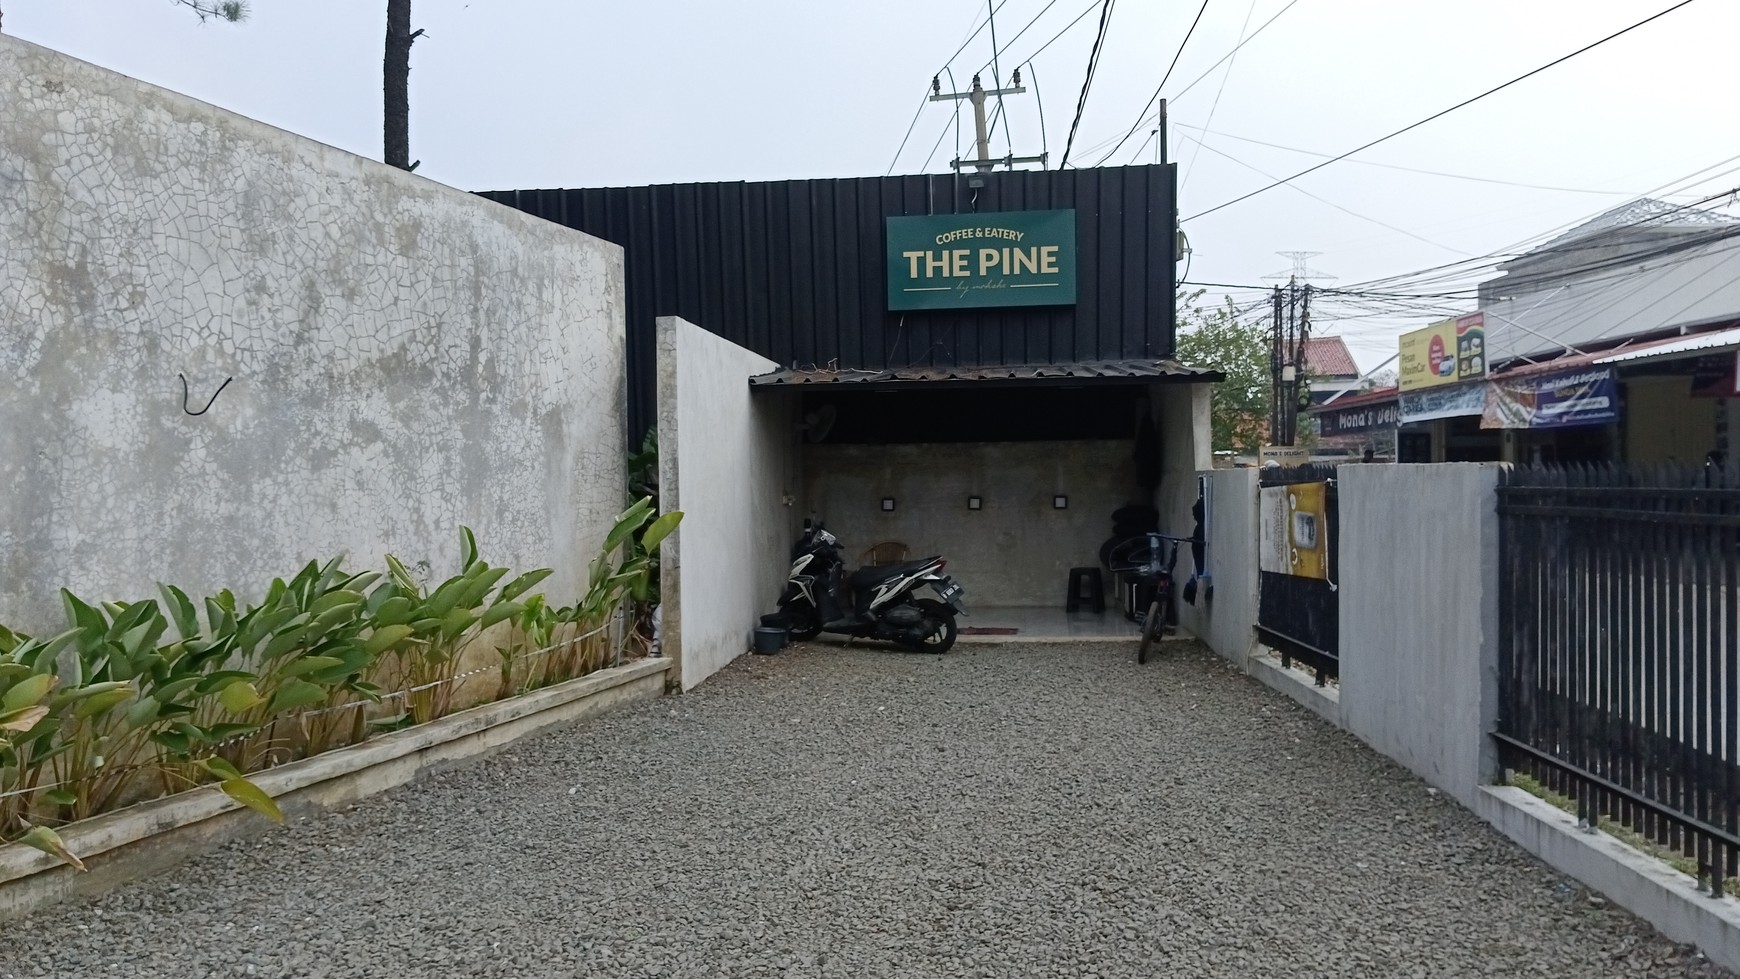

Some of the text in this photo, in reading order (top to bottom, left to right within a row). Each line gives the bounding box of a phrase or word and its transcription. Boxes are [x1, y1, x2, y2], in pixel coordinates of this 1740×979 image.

[935, 227, 1025, 245] COFFEE & EATERY
[902, 245, 1059, 279] THE PINE
[1338, 409, 1373, 429] Mona's
